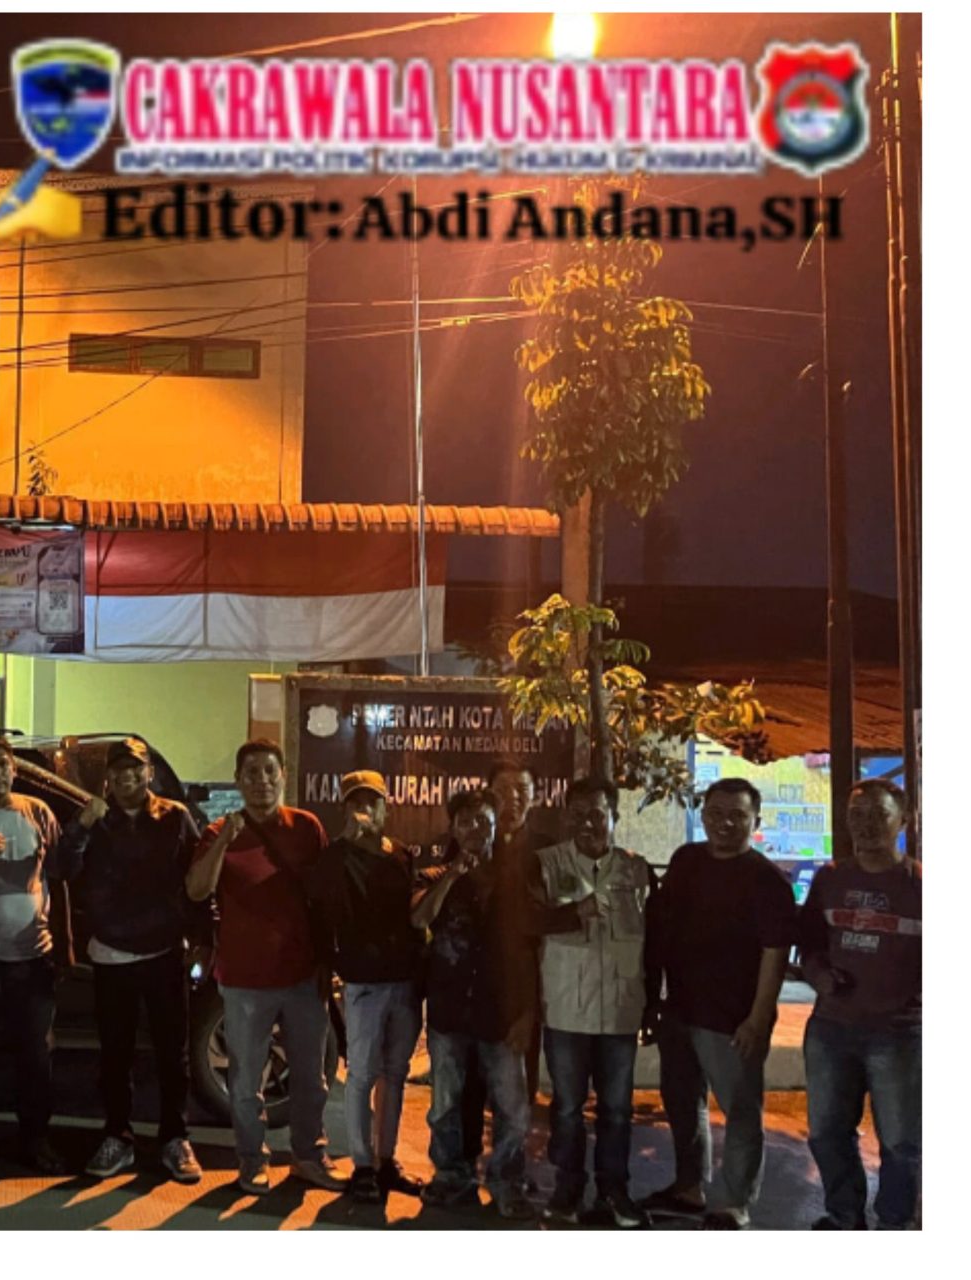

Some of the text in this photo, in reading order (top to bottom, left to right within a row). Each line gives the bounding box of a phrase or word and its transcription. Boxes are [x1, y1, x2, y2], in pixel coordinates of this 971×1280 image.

[351, 703, 455, 730] PEMERNTAH
[459, 705, 505, 731] KOTA
[375, 733, 544, 754] KECAMATAN MEDAN DELI
